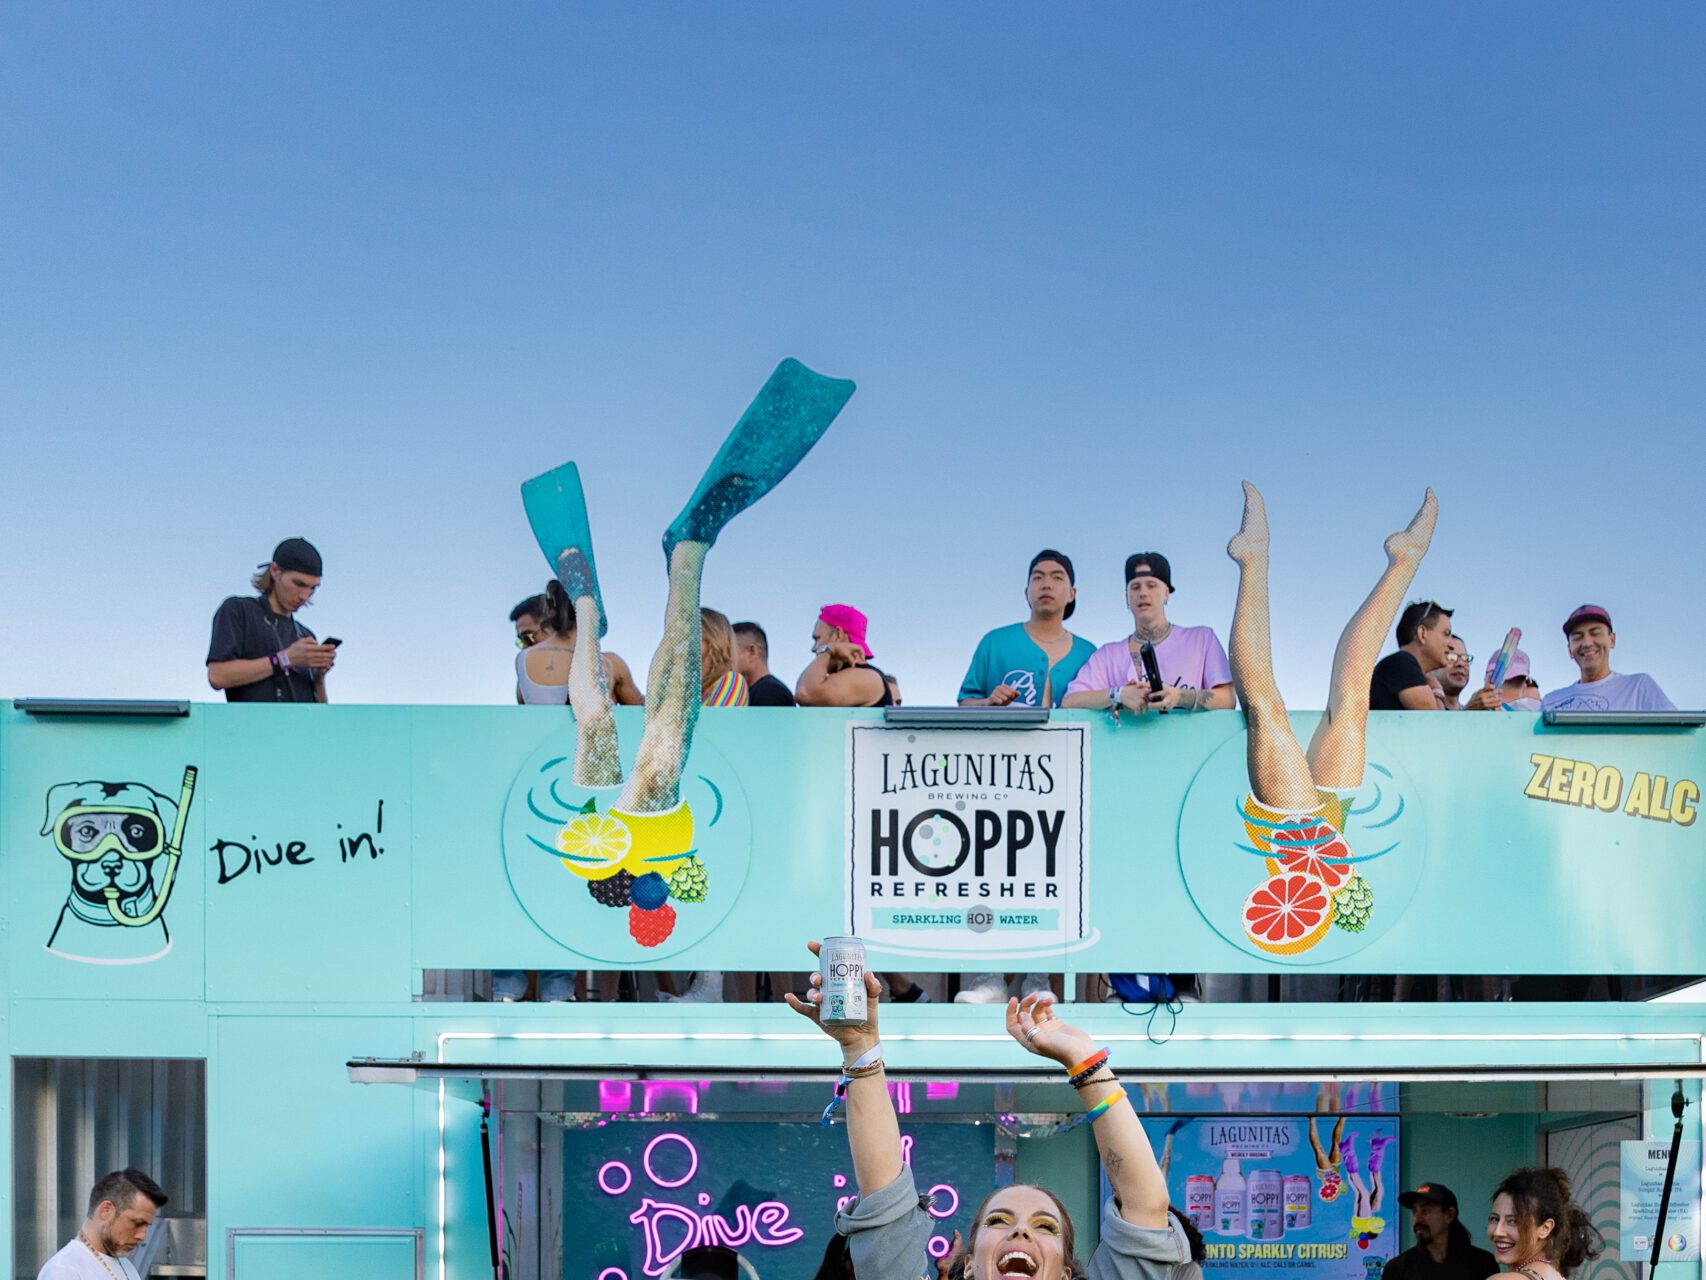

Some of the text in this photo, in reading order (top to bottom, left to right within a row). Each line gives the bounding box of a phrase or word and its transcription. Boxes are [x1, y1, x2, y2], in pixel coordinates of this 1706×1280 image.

[881, 753, 1054, 796] LAGUNITAS
[1524, 753, 1700, 826] ZERO ALC
[209, 799, 385, 885] Dive in!
[871, 808, 1065, 877] HOPPY
[871, 882, 1058, 898] REFRESHER
[892, 912, 1039, 925] SPARKLING HOP WATER
[829, 963, 864, 978] HOPPY
[1210, 1126, 1290, 1146] LAGUNITAS
[1251, 1192, 1280, 1205] HOPPY
[629, 1192, 804, 1277] Dive
[1238, 1243, 1295, 1261] SPARKLY
[1297, 1243, 1348, 1261] CITRUS!
